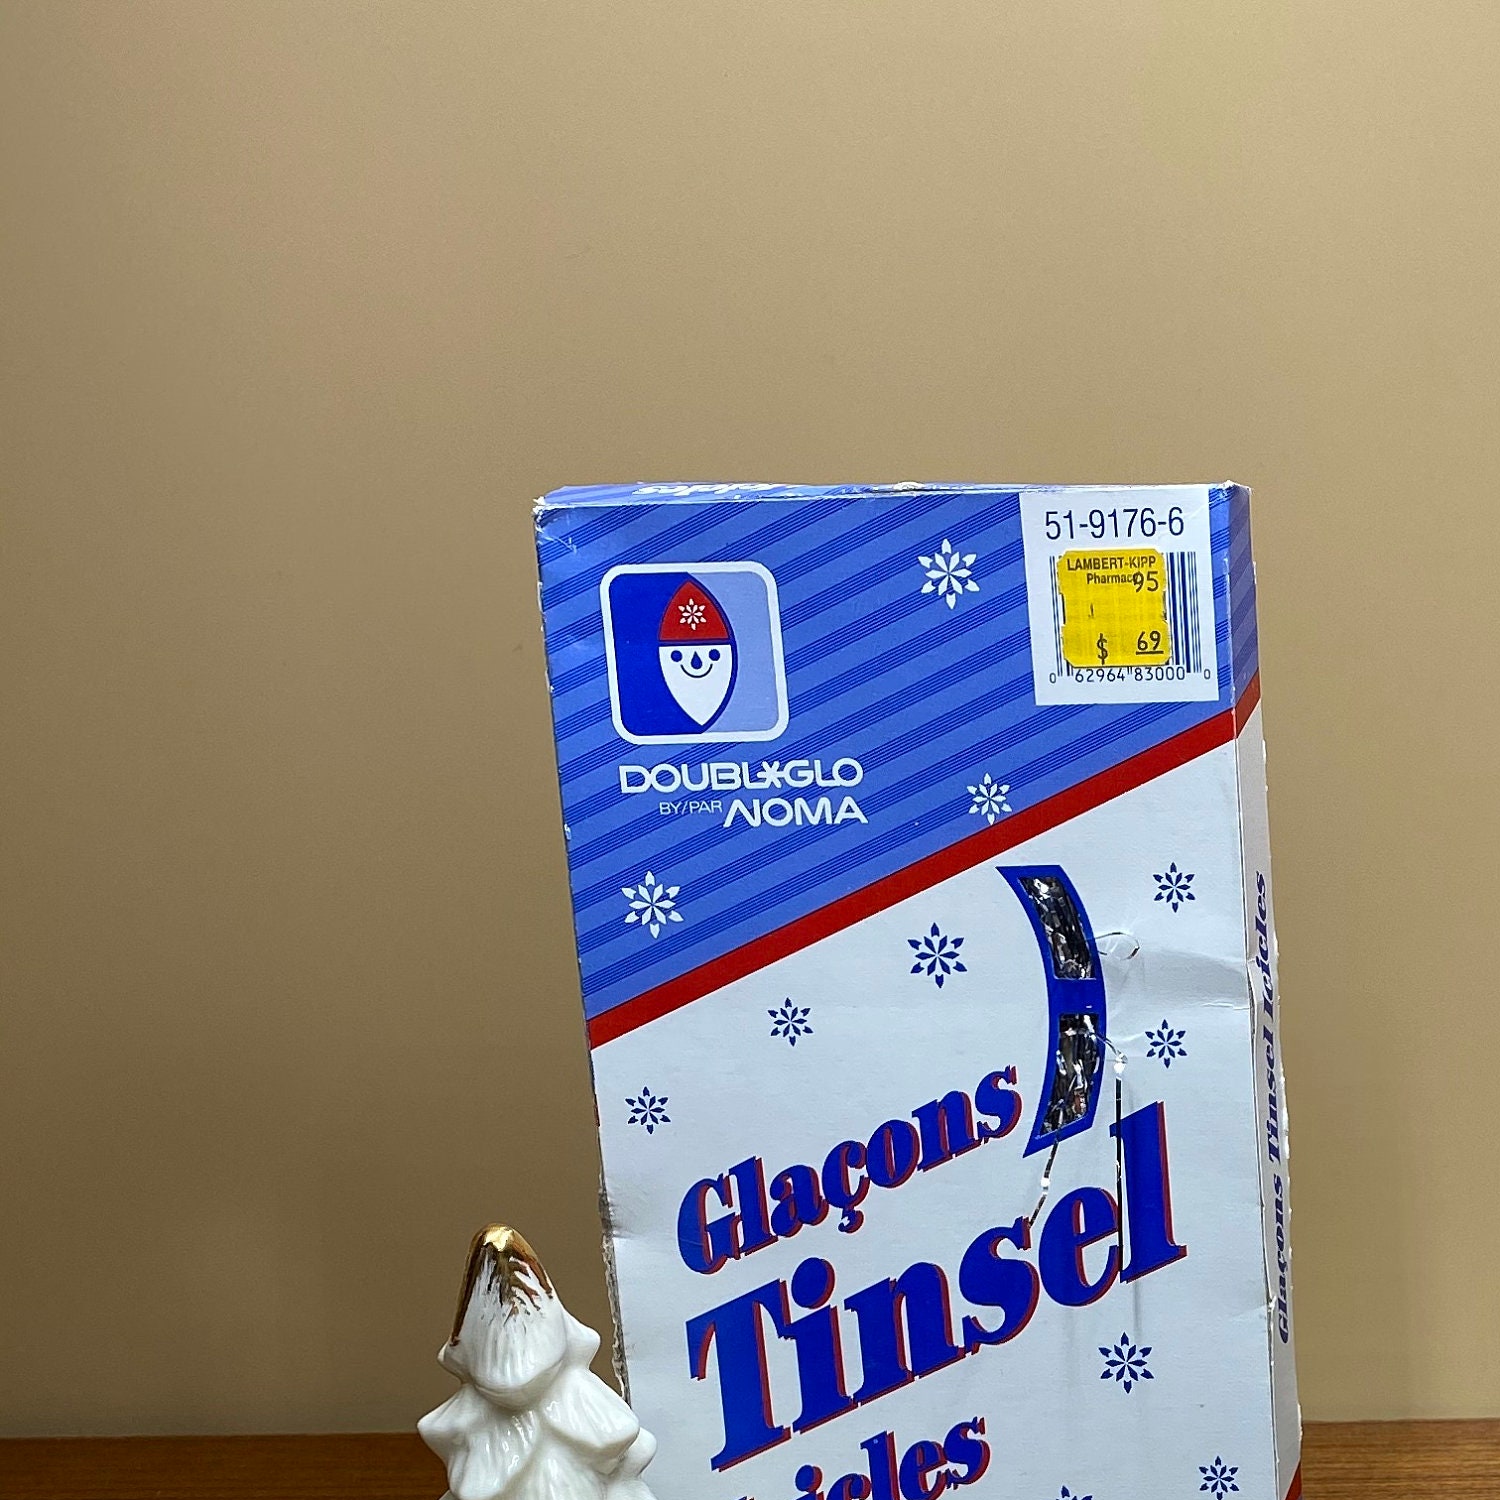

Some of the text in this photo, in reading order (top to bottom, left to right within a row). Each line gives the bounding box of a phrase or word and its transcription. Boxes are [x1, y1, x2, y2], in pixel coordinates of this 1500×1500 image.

[1045, 506, 1185, 540] 51-9176-6
[1066, 555, 1157, 571] LAMBERT-KIPP
[1136, 631, 1162, 652] 69
[1074, 667, 1126, 683] 62964
[1134, 666, 1186, 682] 83000
[658, 796, 869, 828] BY/PAR NOMA
[1252, 871, 1290, 1344] Glaçons Tinsel Icicles
[677, 1065, 1023, 1275] Glaçons
[685, 1101, 1188, 1472] Tinsel
